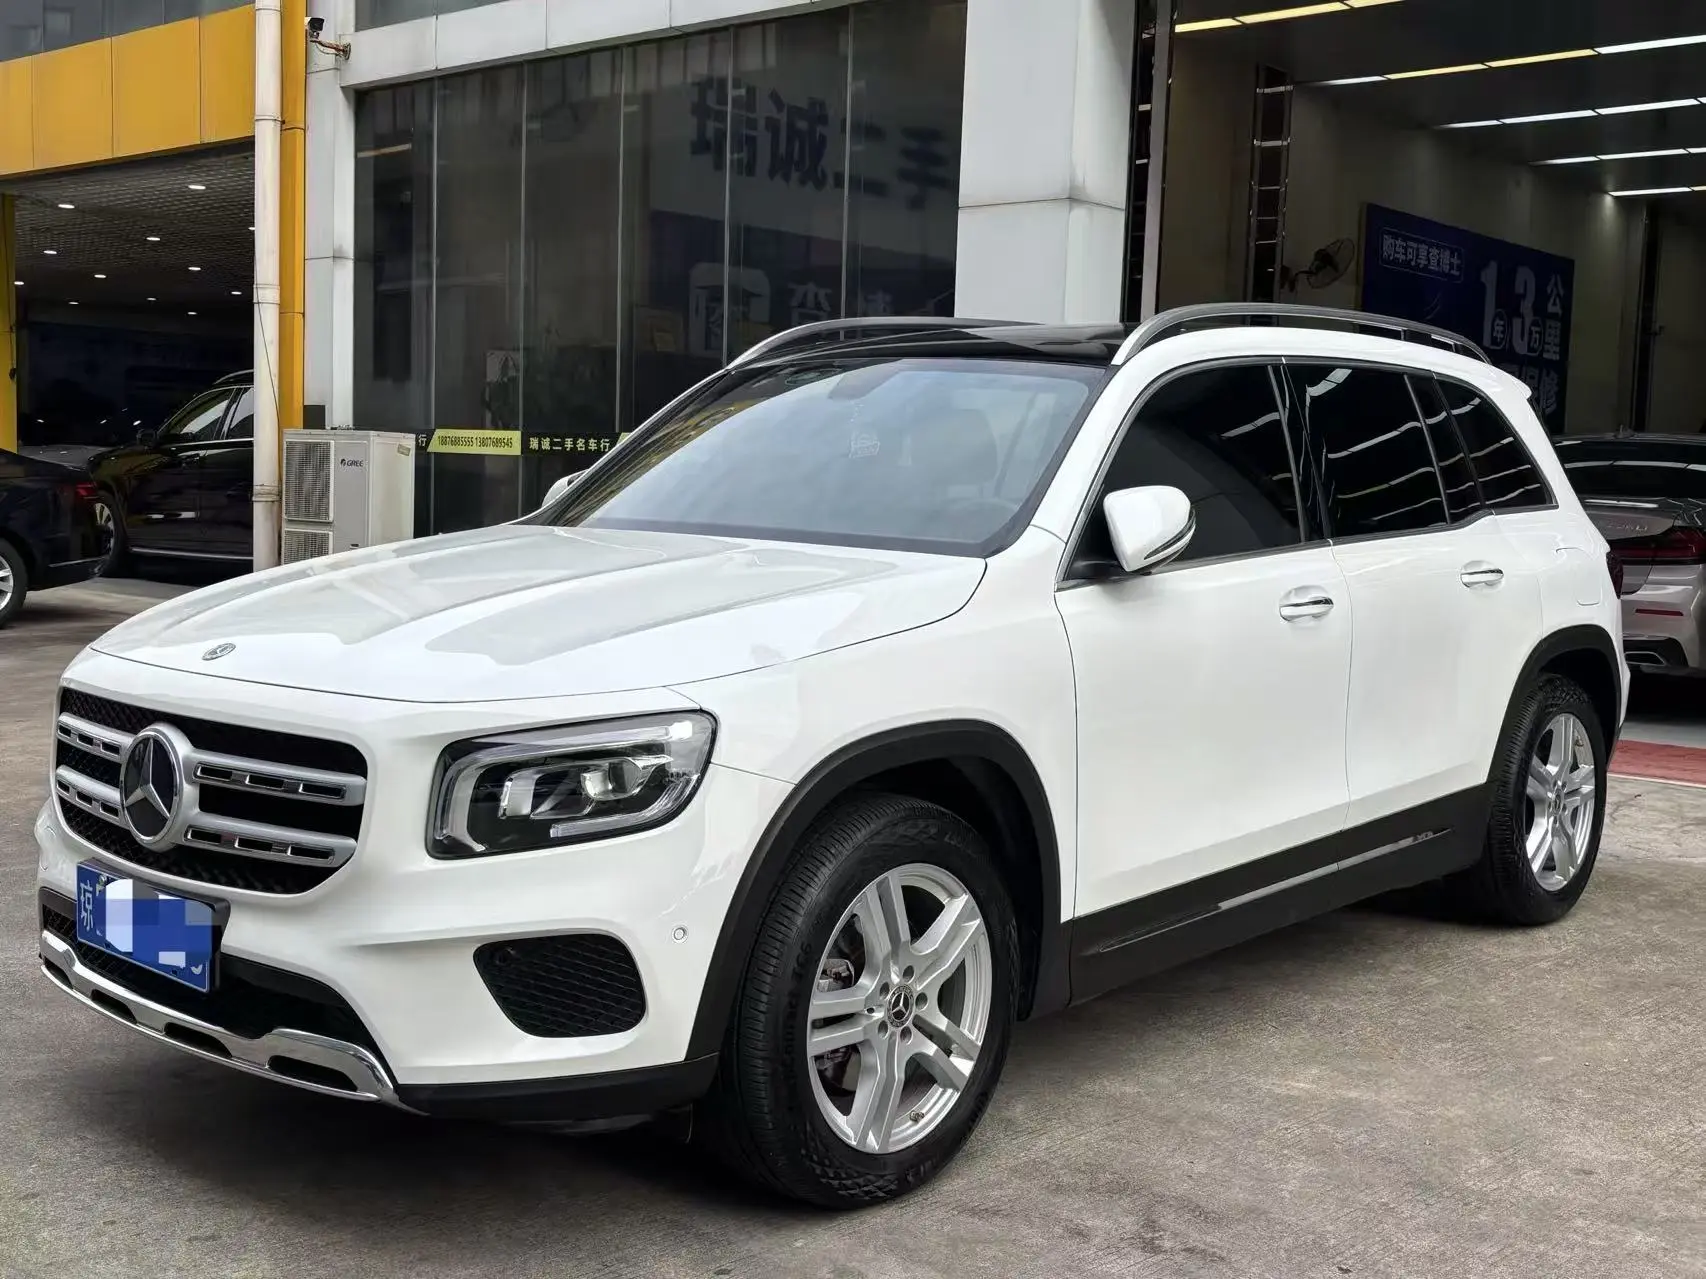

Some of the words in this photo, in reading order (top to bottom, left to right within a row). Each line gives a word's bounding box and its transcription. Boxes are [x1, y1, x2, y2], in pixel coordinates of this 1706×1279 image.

[1383, 234, 1462, 276] 购车可享查博士
[529, 436, 611, 452] 瑞诚二手名车行
[80, 879, 94, 932] 琼
